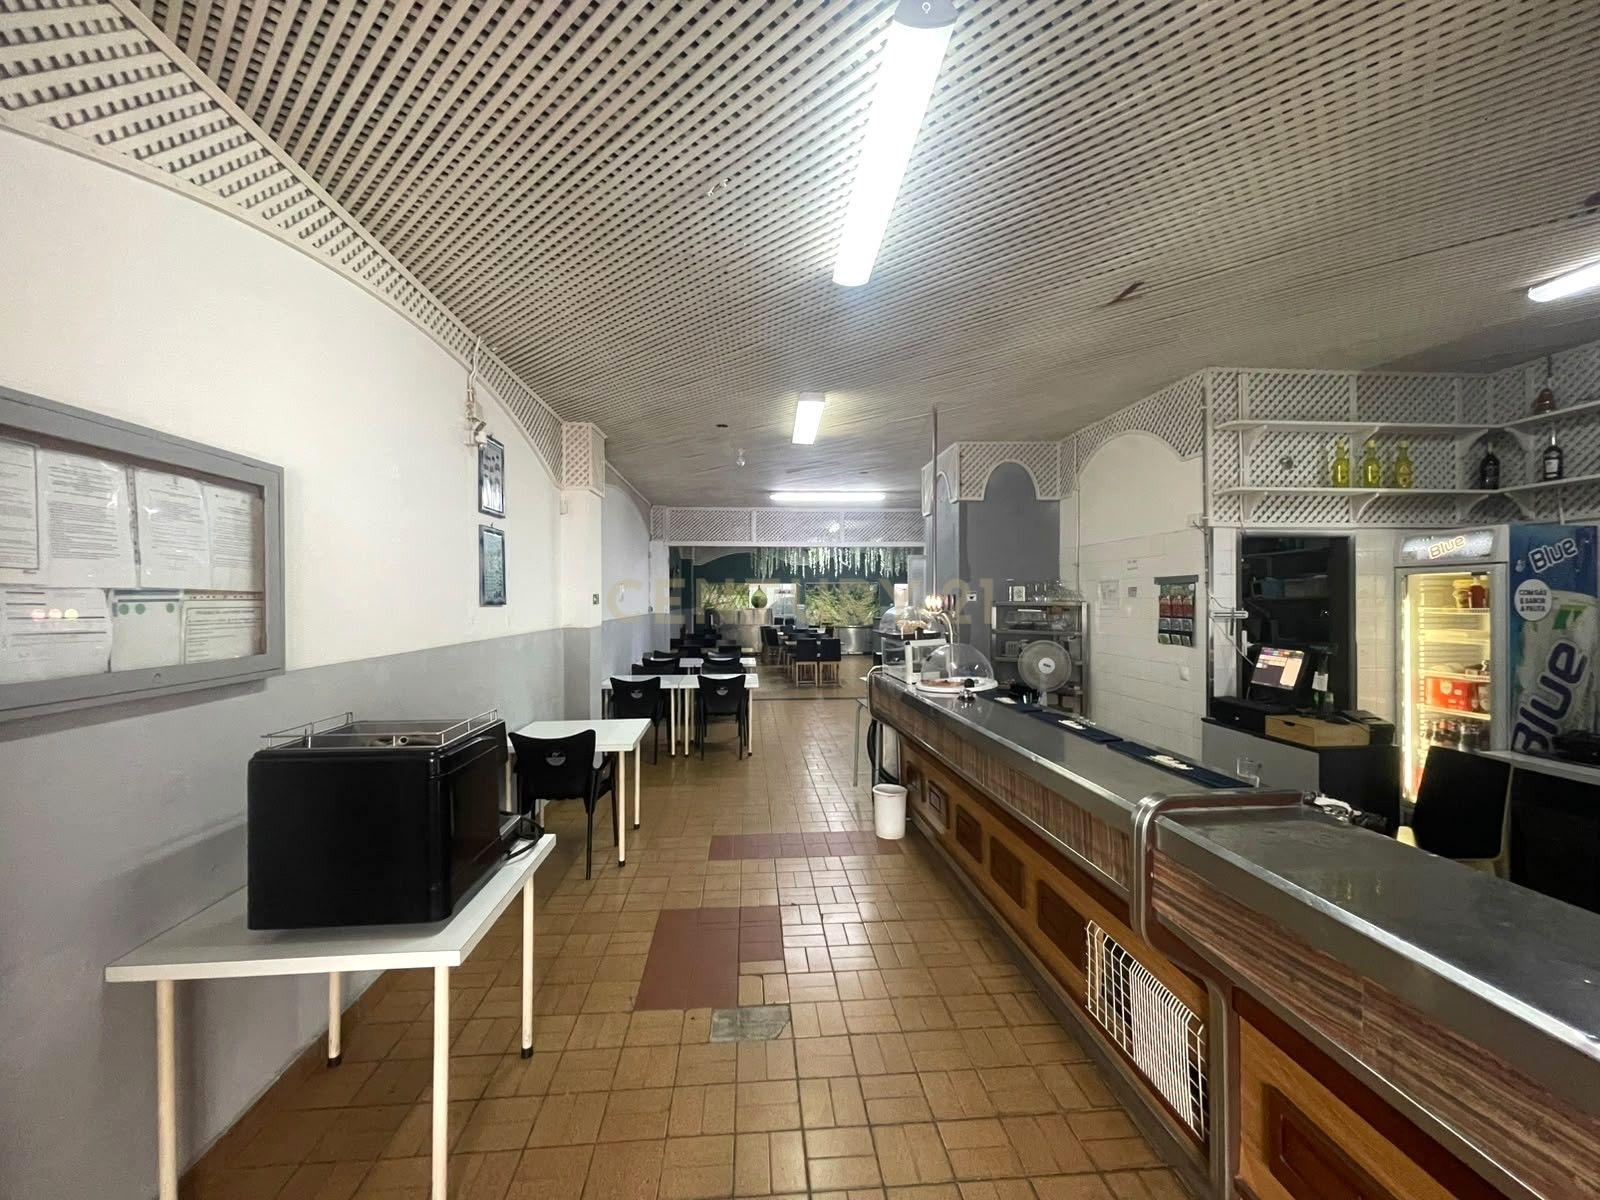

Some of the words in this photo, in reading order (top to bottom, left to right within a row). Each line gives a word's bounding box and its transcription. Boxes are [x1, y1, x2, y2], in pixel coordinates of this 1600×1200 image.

[1429, 535, 1466, 559] Blue
[1529, 538, 1577, 573] Blue
[1510, 642, 1588, 754] Blue
